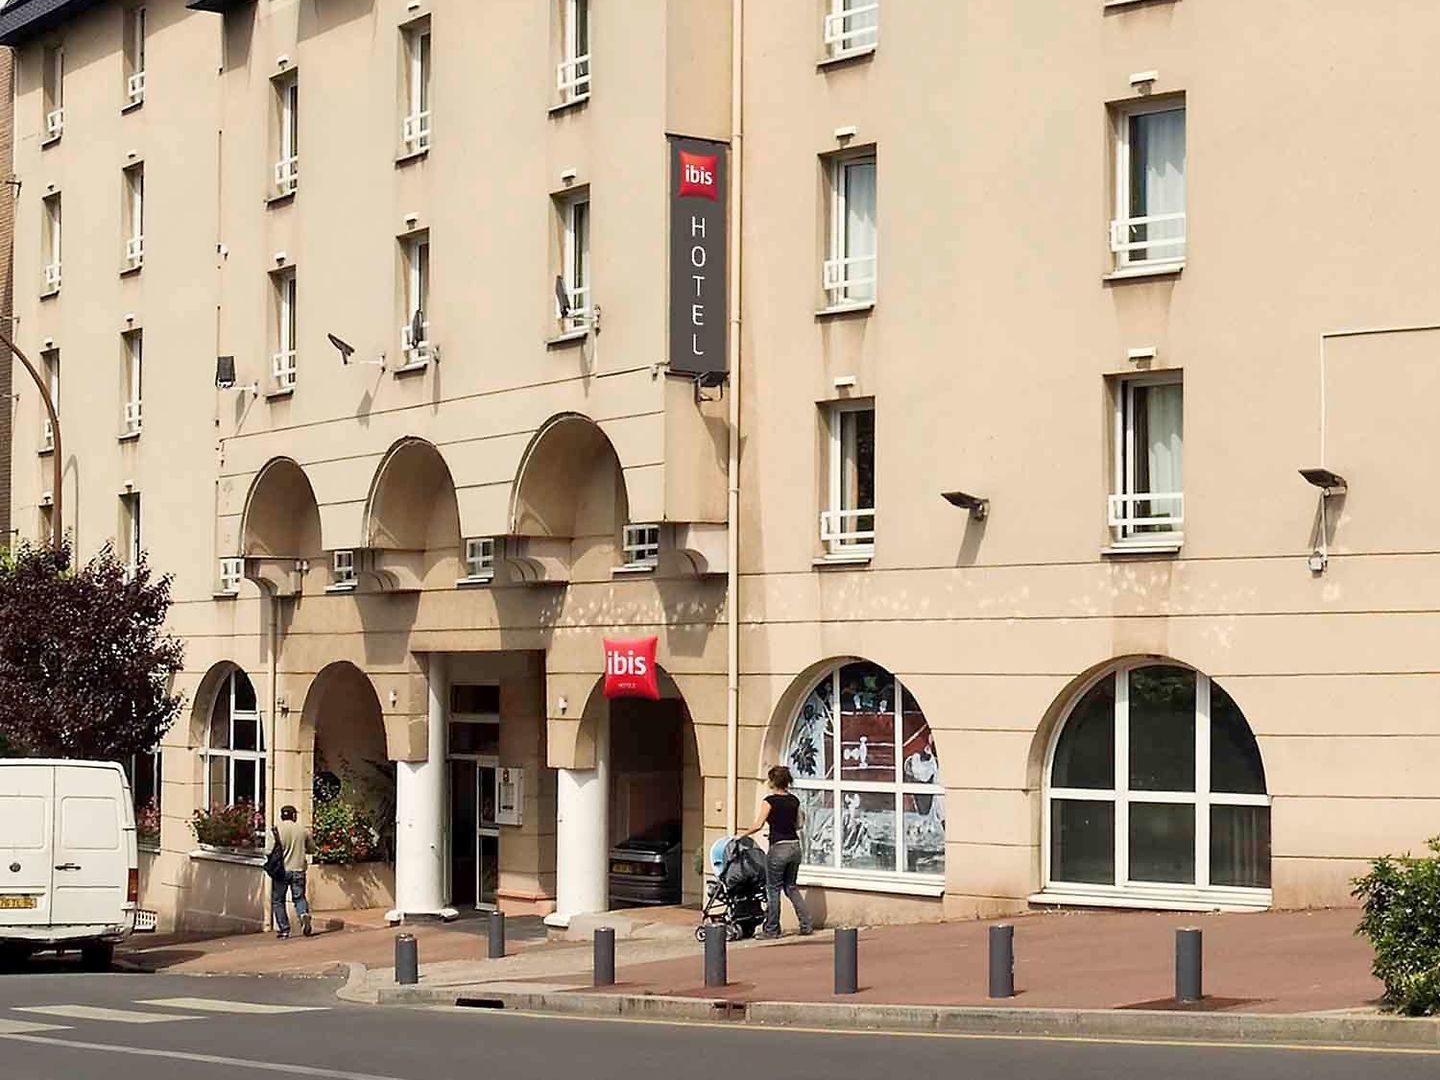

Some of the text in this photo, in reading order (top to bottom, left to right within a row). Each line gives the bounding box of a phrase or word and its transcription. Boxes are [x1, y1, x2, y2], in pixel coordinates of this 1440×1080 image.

[685, 164, 712, 186] ibis
[691, 216, 706, 356] HOTEL
[607, 650, 647, 676] ibis
